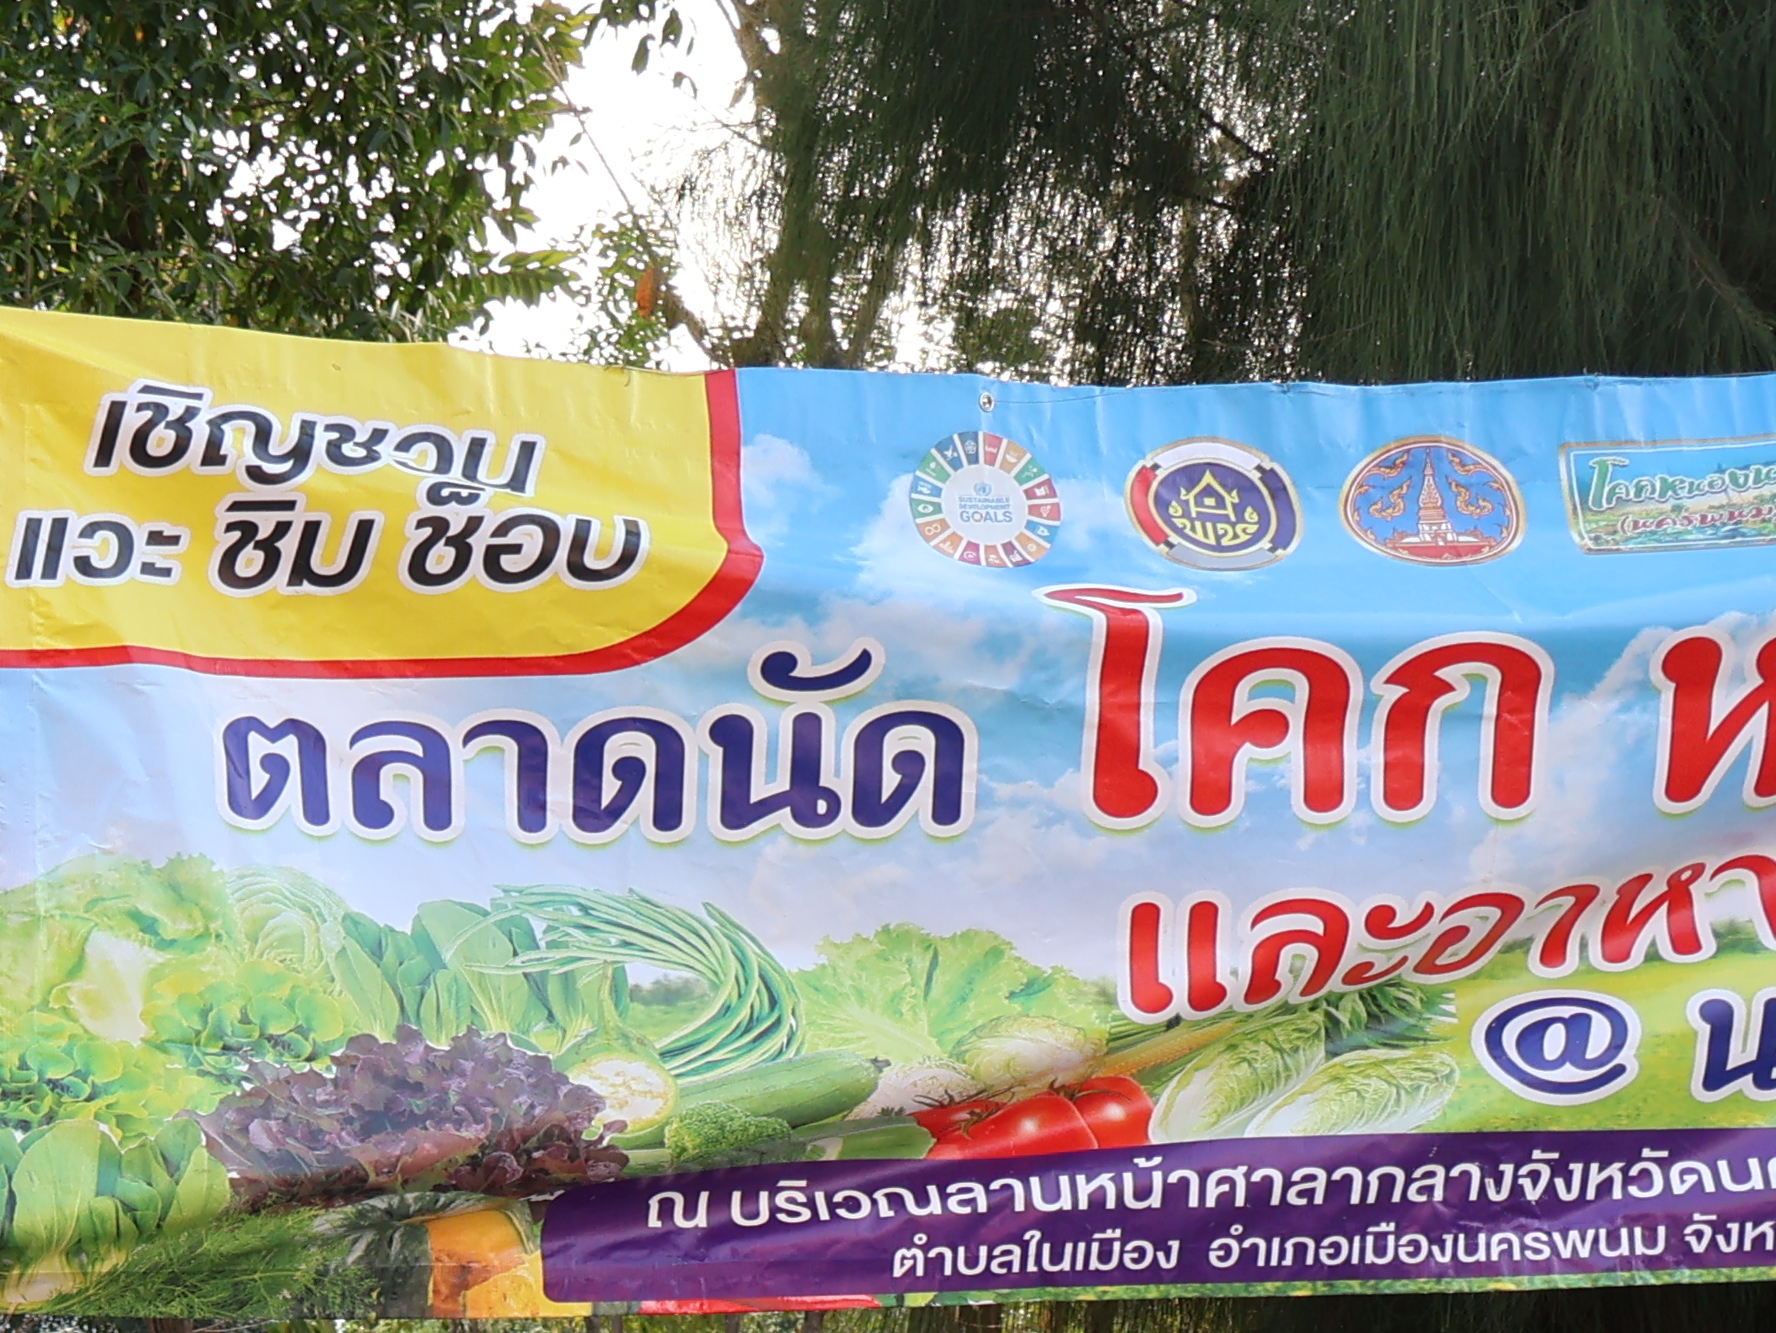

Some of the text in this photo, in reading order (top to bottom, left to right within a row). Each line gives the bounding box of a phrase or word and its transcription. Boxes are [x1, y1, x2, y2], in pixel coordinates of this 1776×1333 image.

[14, 516, 182, 581] แวะ
[216, 499, 375, 588] ชิม
[959, 510, 1014, 523] GOALS
[222, 647, 968, 834] ตลาดนัด
[1045, 588, 1543, 817] โคก
[1482, 997, 1629, 1094] @
[648, 1189, 708, 1230] ณ
[892, 1229, 1180, 1278] ตำบลในเมือง
[1209, 1222, 1666, 1269] อำเภอเมืองนครพนม
